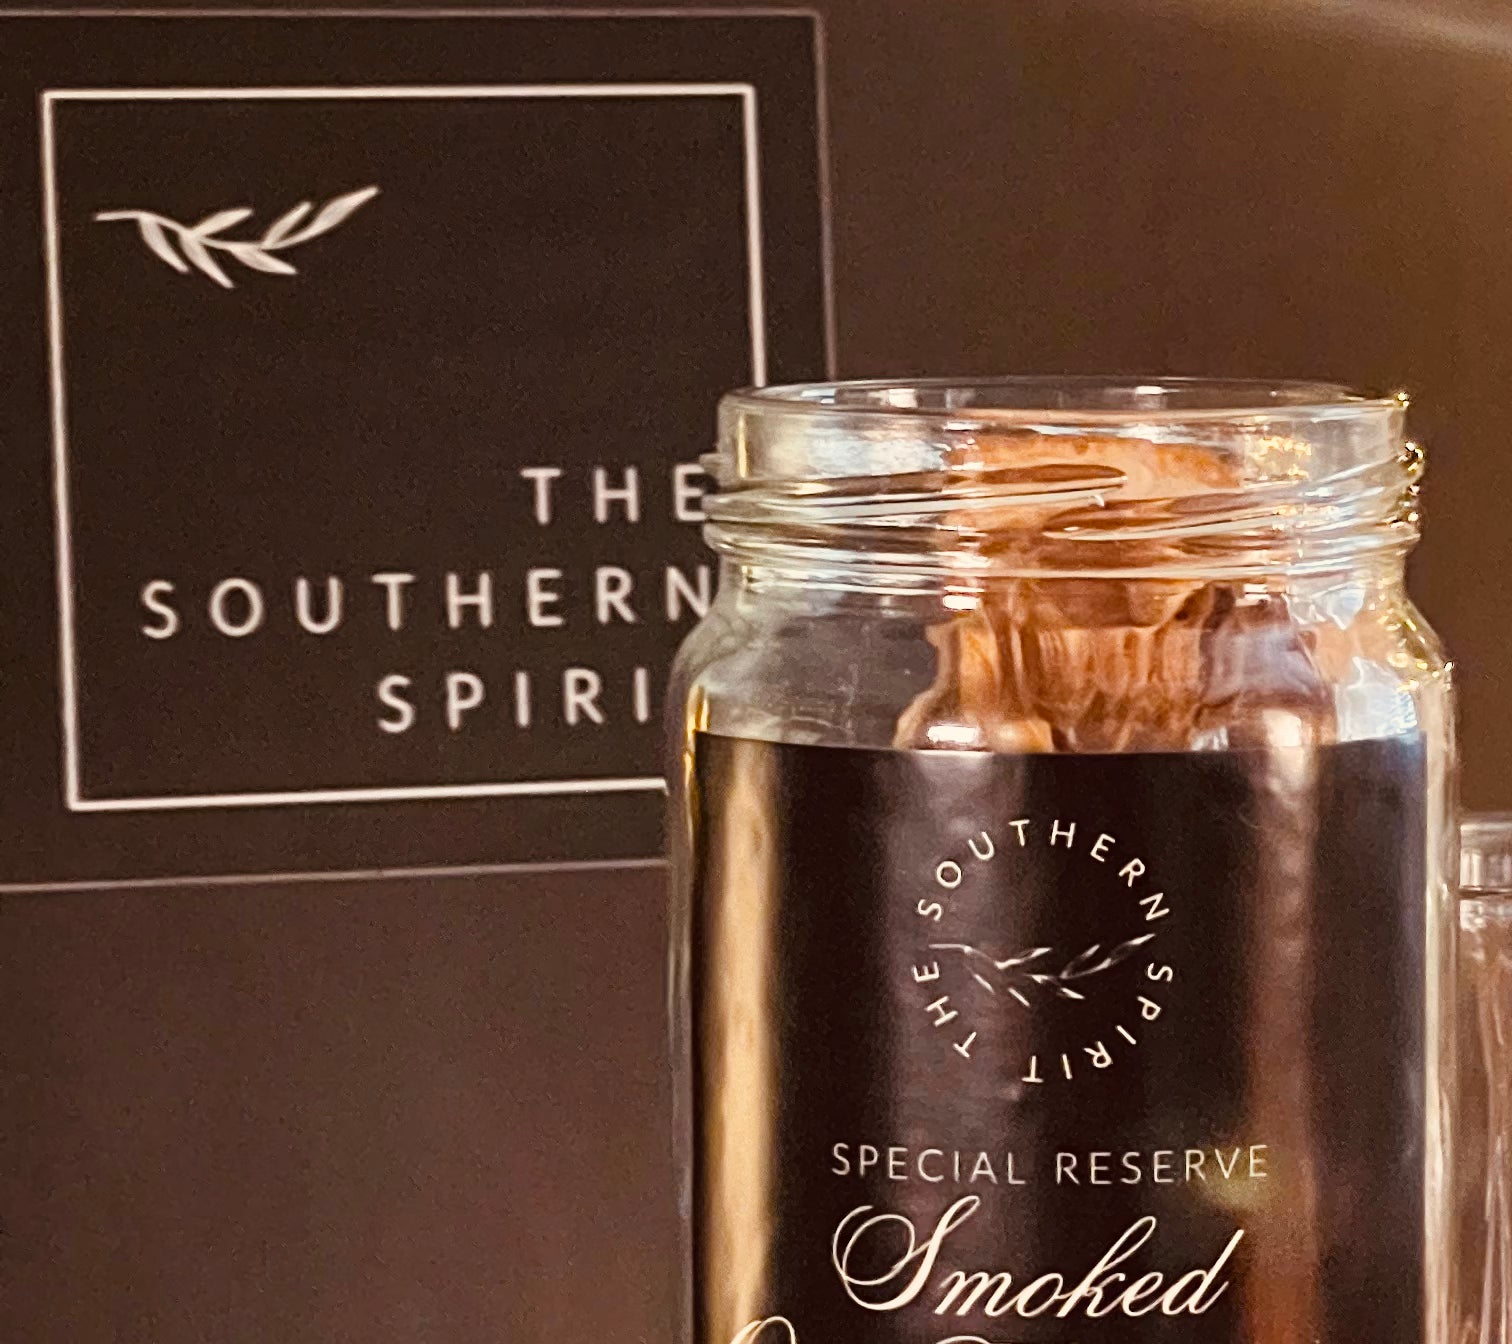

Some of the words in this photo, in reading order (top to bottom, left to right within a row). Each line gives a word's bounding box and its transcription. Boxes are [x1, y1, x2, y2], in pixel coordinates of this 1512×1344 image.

[521, 465, 707, 524] THE
[141, 564, 712, 640] SOUTHERN
[376, 666, 650, 734] SPIRI
[916, 818, 1170, 922] SOUTHERN
[911, 961, 978, 1058] THE
[1020, 962, 1174, 1084] SPIRIT
[831, 1143, 1026, 1186] SPECIAL
[1056, 1144, 1269, 1186] RESERVE
[832, 1195, 1245, 1318] Smoked
